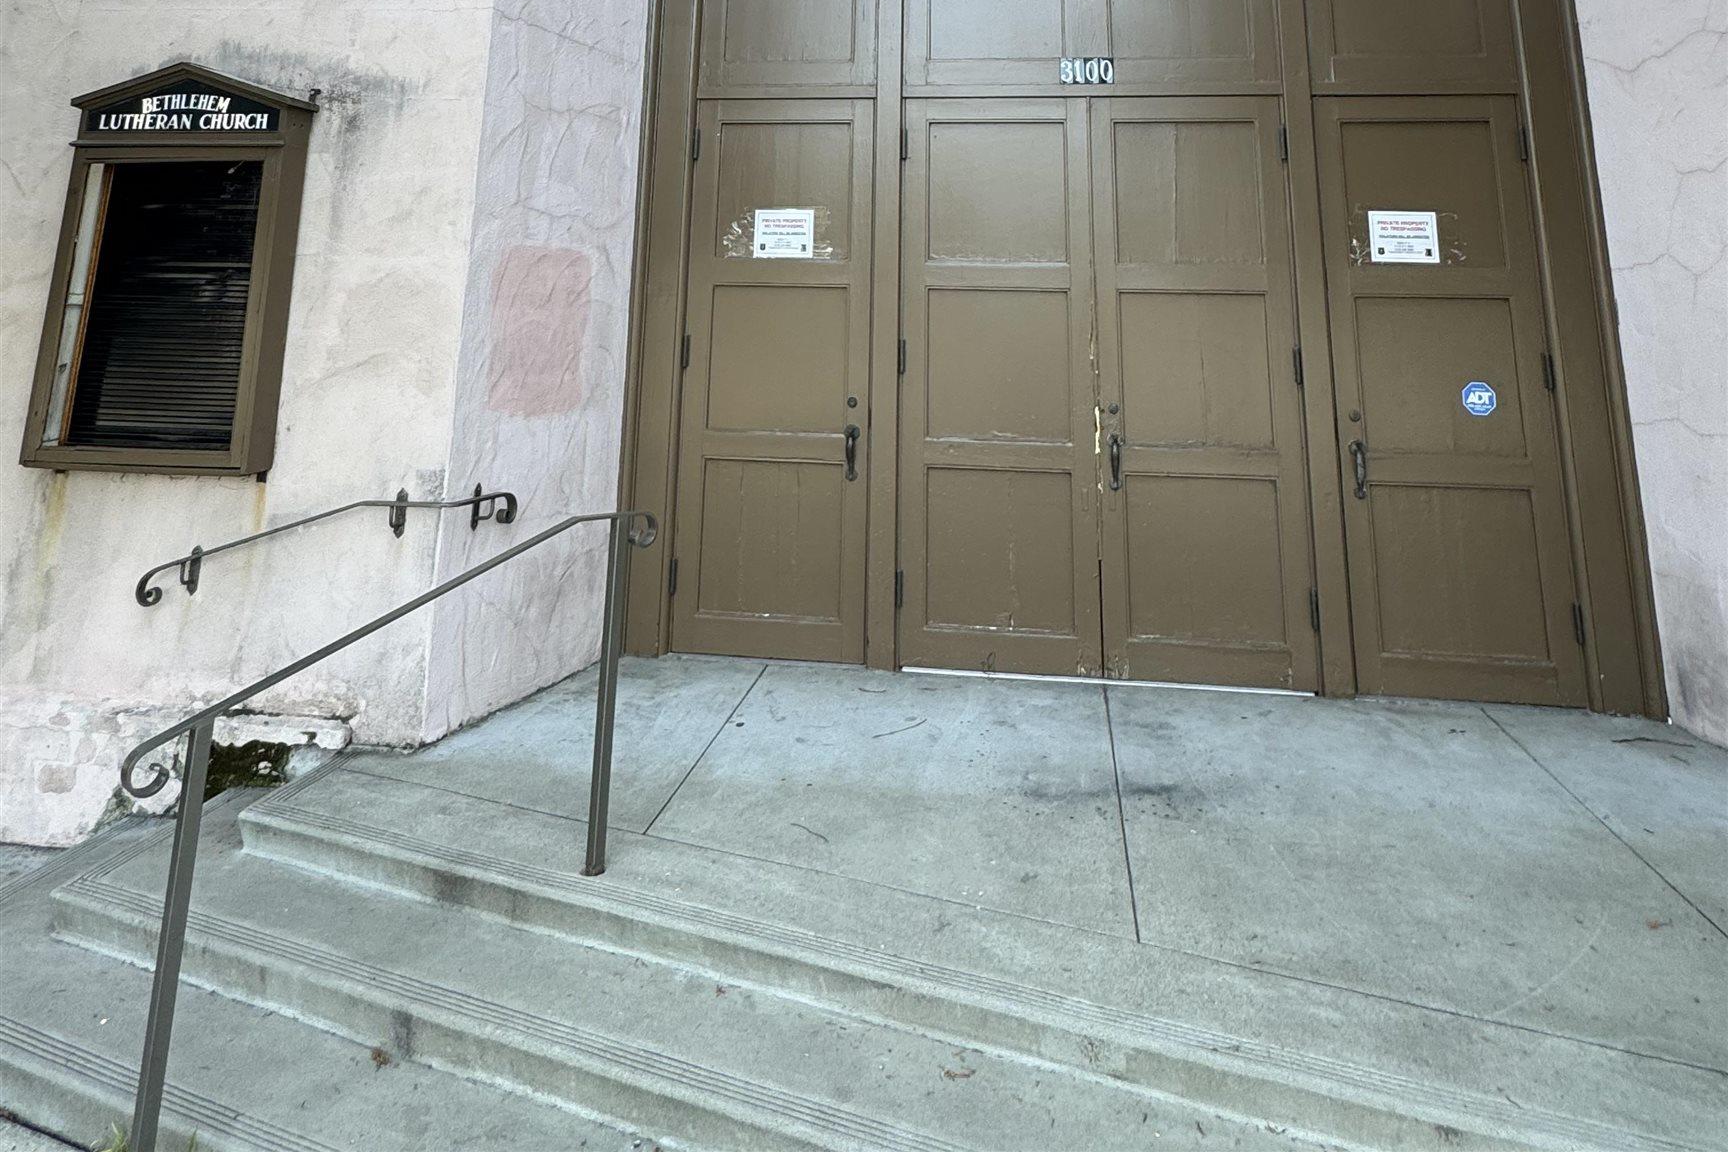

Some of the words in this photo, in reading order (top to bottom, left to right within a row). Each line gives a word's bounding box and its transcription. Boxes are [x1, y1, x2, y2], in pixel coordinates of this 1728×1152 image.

[1060, 59, 1113, 83] 3100
[142, 94, 231, 113] BETHLEHEM
[99, 114, 193, 130] LUTHERAN
[199, 113, 268, 130] CHURCH
[1466, 391, 1493, 405] ADT
